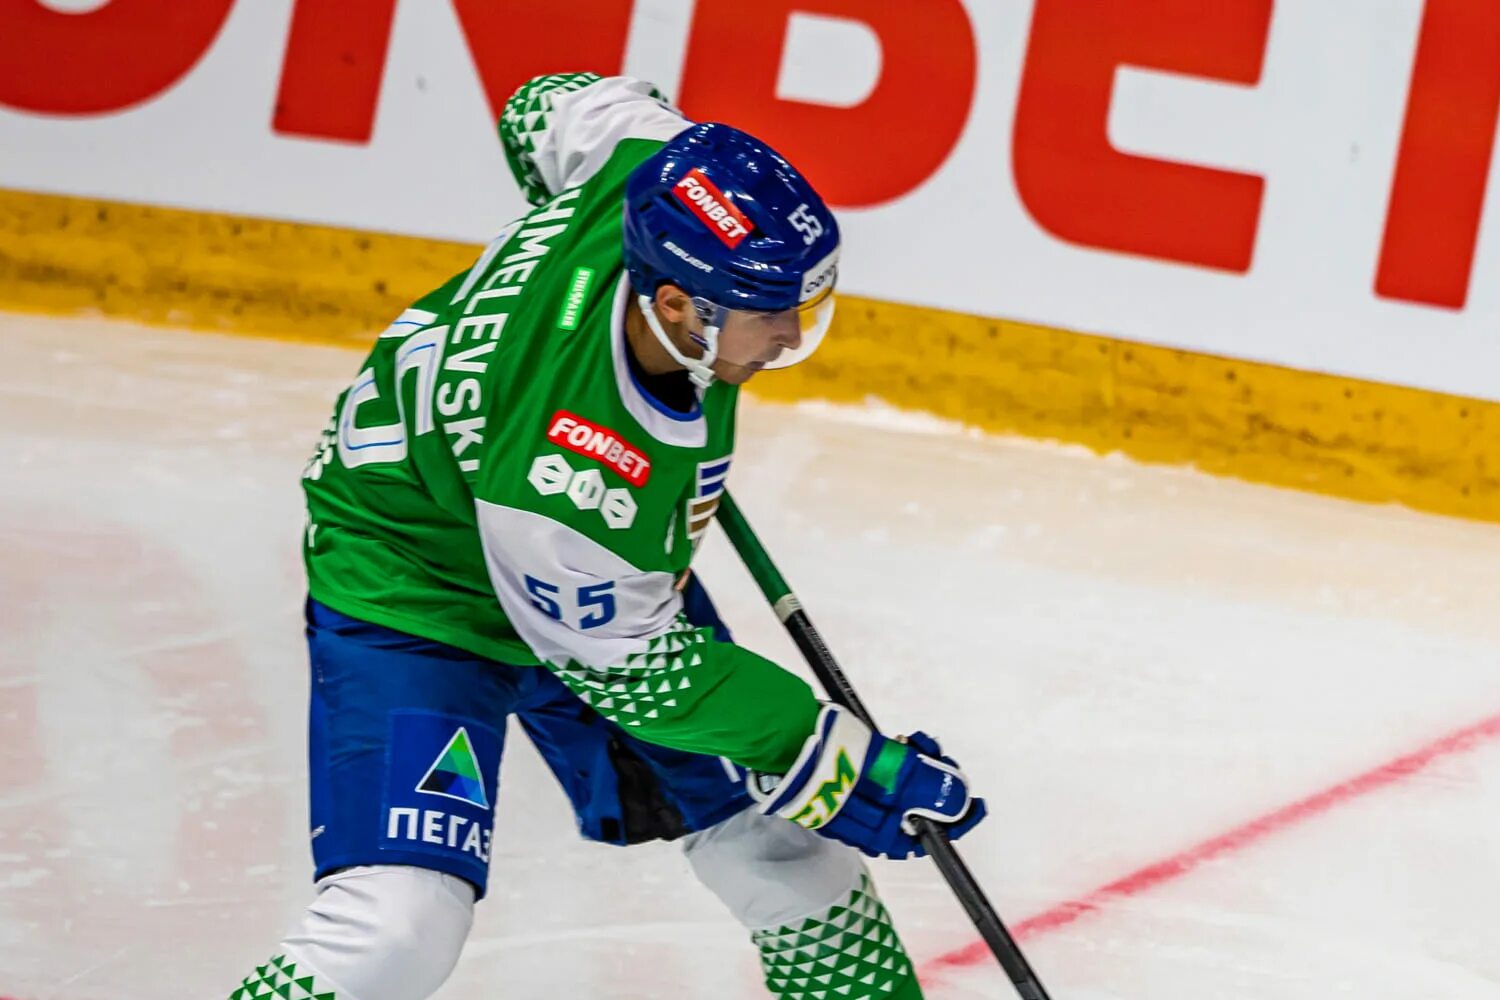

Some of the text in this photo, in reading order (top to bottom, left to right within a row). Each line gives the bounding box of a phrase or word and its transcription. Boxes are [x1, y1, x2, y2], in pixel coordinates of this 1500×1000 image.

[677, 176, 748, 238] FONBET
[787, 203, 823, 245] 55
[662, 241, 714, 273] BAUER
[548, 417, 650, 479] FONBET
[524, 574, 616, 630] 55
